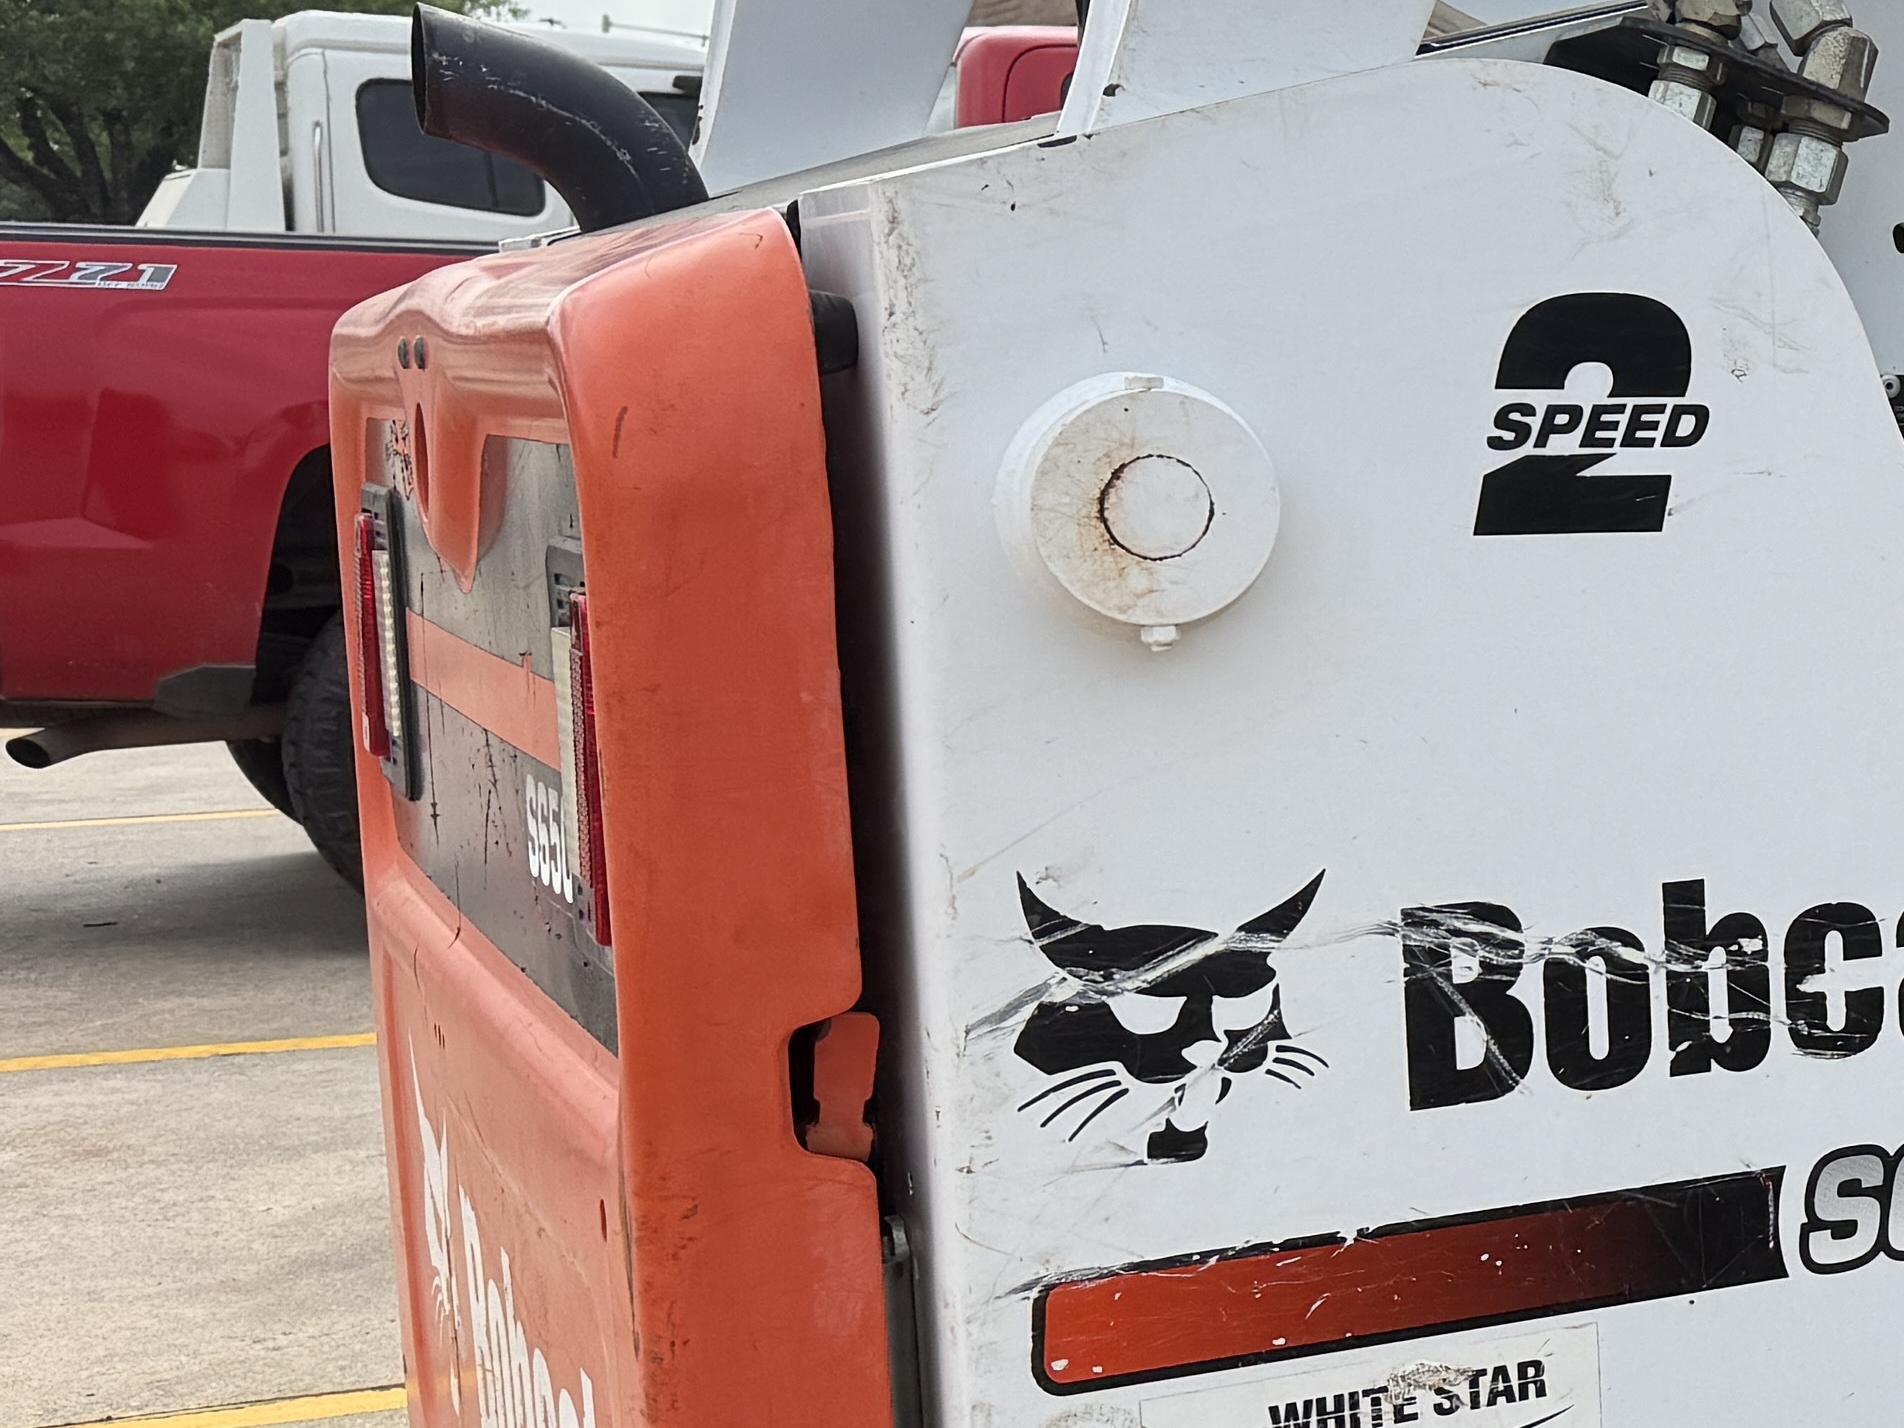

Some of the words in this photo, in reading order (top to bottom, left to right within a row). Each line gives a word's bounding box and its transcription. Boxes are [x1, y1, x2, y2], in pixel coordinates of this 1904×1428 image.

[1473, 291, 1692, 536] 2
[1486, 402, 1710, 451] SPEED
[1432, 1358, 1548, 1420] STAR
